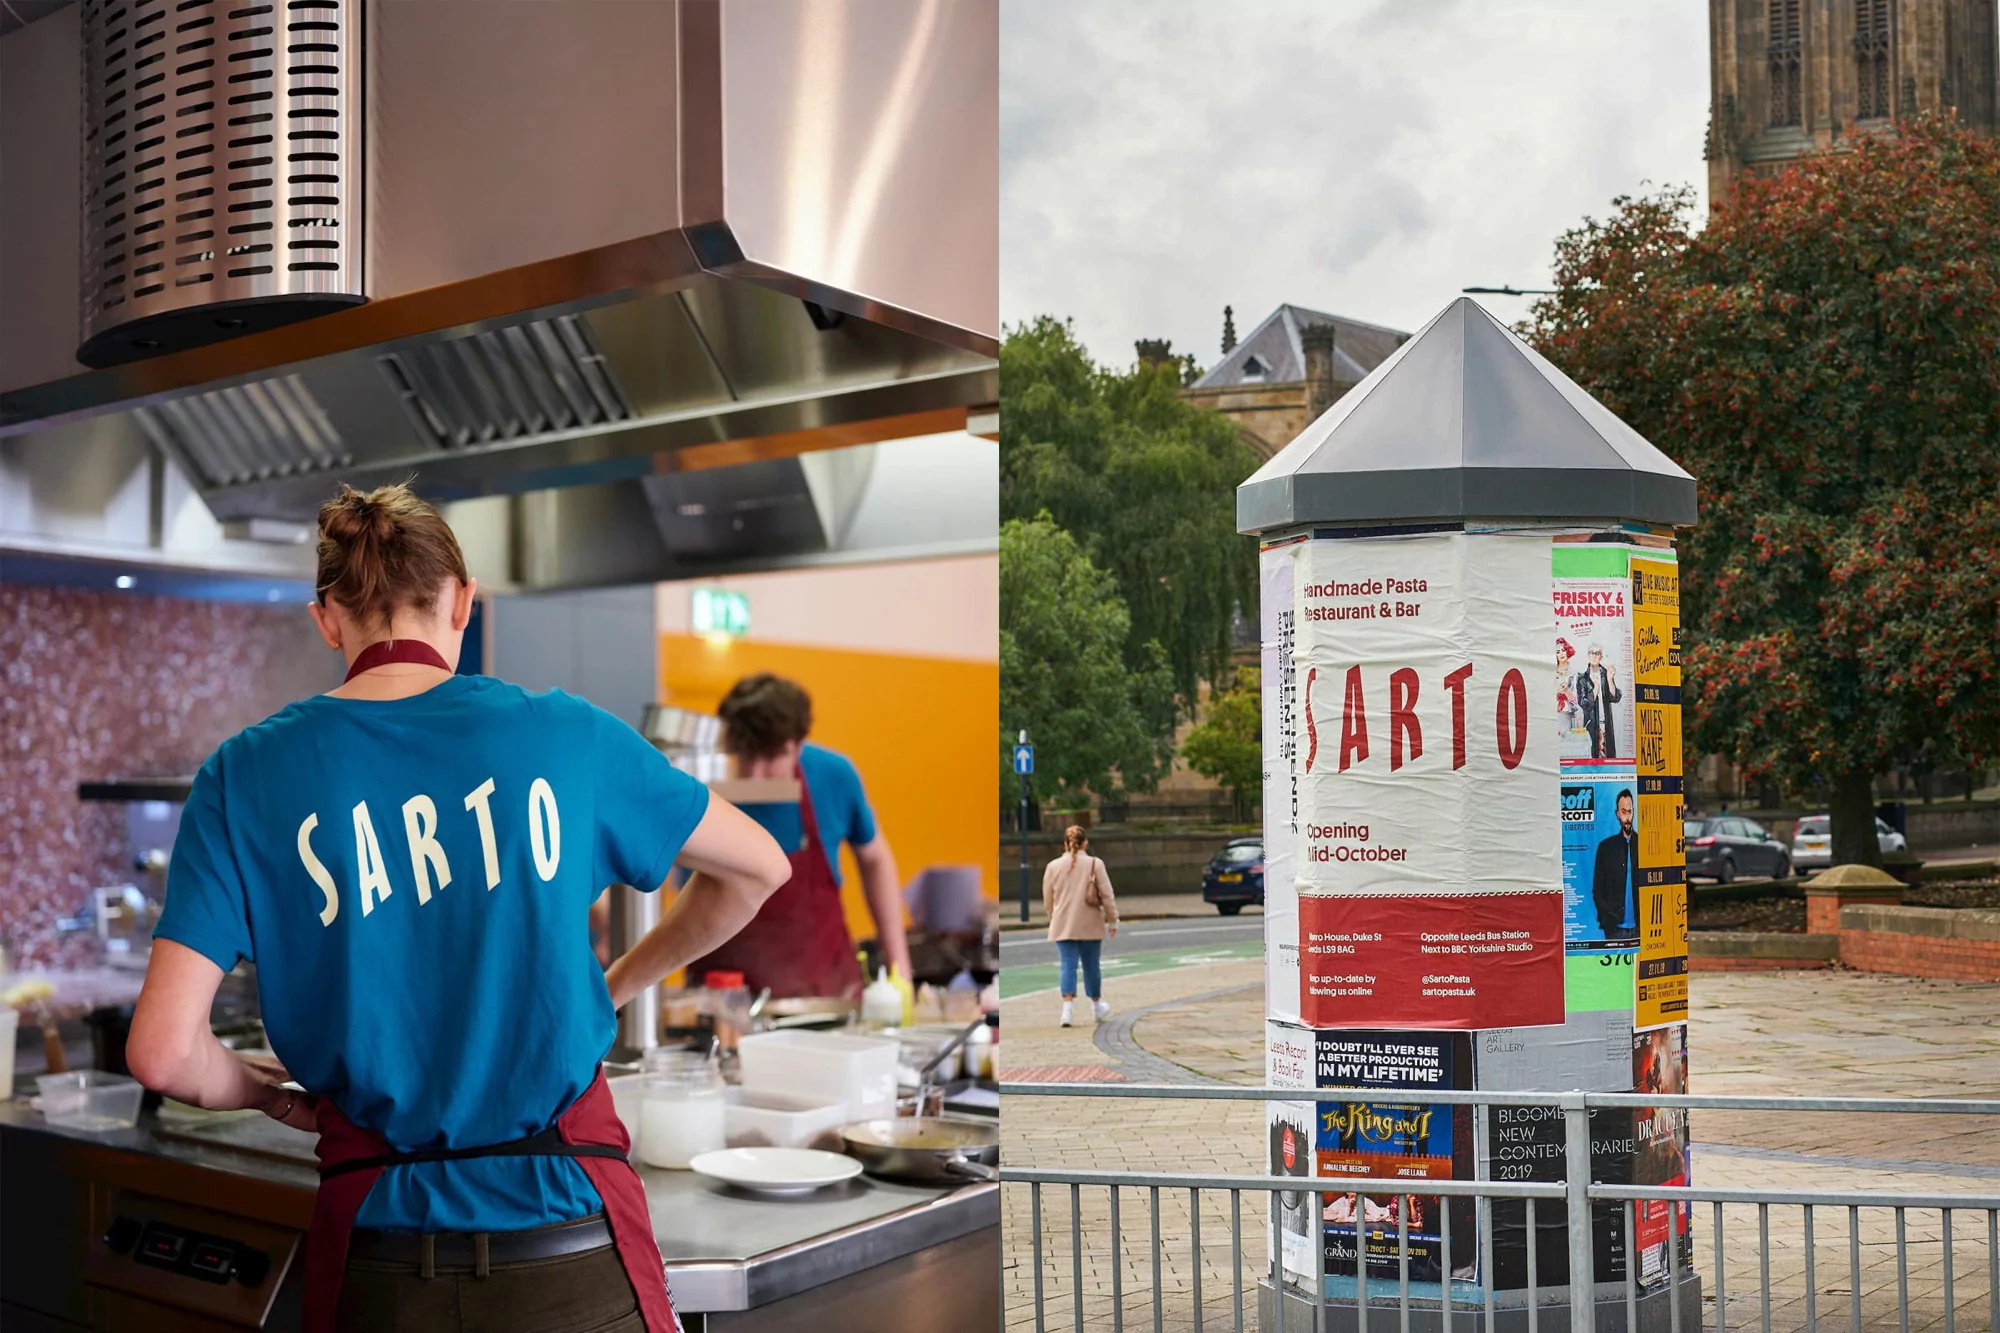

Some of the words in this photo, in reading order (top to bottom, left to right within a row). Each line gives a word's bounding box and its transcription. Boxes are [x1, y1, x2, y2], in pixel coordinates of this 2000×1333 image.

[1304, 578, 1383, 599] Handmade
[1386, 577, 1428, 595] Pasta
[1553, 591, 1613, 605] FRISKY
[1615, 591, 1625, 605] &
[1304, 602, 1376, 623] Restaurant
[1379, 601, 1392, 618] &
[1395, 601, 1421, 618] Bar
[1554, 605, 1625, 617] MANNISH
[1305, 662, 1529, 775] SARTO
[1640, 709, 1663, 735] MILES
[1641, 736, 1663, 766] KANE
[1307, 821, 1369, 842] Opening
[1565, 823, 1595, 831] LIBERTIES
[297, 777, 560, 927] SARTO
[1324, 932, 1352, 942] House,
[1353, 932, 1373, 941] Duke
[1374, 932, 1382, 941] St
[1420, 932, 1459, 942] Opposite
[1460, 931, 1486, 941] Leeds
[1487, 931, 1501, 940] Bus
[1502, 930, 1530, 940] Station
[1323, 945, 1336, 954] LS9
[1337, 945, 1355, 954] 8AG
[1421, 945, 1440, 954] Next
[1441, 945, 1450, 954] to
[1451, 944, 1467, 954] BBC
[1469, 942, 1506, 954] Yorkshire
[1506, 942, 1533, 952] Studio
[1321, 973, 1364, 985] up-to-date
[1365, 974, 1376, 985] by
[1421, 975, 1470, 984] @SartoPasta
[1337, 988, 1347, 996] us
[1348, 986, 1373, 996] online
[1422, 987, 1476, 997] sartopasta.uk
[1486, 1035, 1503, 1044] ART
[1271, 1037, 1285, 1056] Leeds
[1285, 1041, 1307, 1061] Record
[1323, 1041, 1362, 1053] DOUBT
[1363, 1043, 1383, 1054] I'LL
[1385, 1044, 1415, 1056] EVER
[1416, 1046, 1439, 1057] SEE
[1486, 1043, 1525, 1054] GALLERY
[1318, 1053, 1326, 1061] A
[1327, 1053, 1367, 1063] BETTER
[1368, 1055, 1439, 1067] PRODUCTION
[1278, 1059, 1292, 1077] Book
[1318, 1062, 1335, 1077] IN
[1337, 1064, 1362, 1078] MY
[1363, 1065, 1443, 1082] LIFETIME'
[1321, 1109, 1348, 1133] The
[1343, 1100, 1394, 1144] King
[1394, 1112, 1420, 1135] and
[1499, 1126, 1536, 1142] NEW
[1499, 1138, 1640, 1161] CONTEMRARIES
[1322, 1162, 1349, 1173] ANNALENE
[1349, 1163, 1371, 1174] BEECHEY
[1397, 1167, 1411, 1176] JOSE
[1411, 1168, 1427, 1177] LLANA
[1499, 1163, 1533, 1180] 2019
[1324, 1247, 1357, 1259] GRAND
